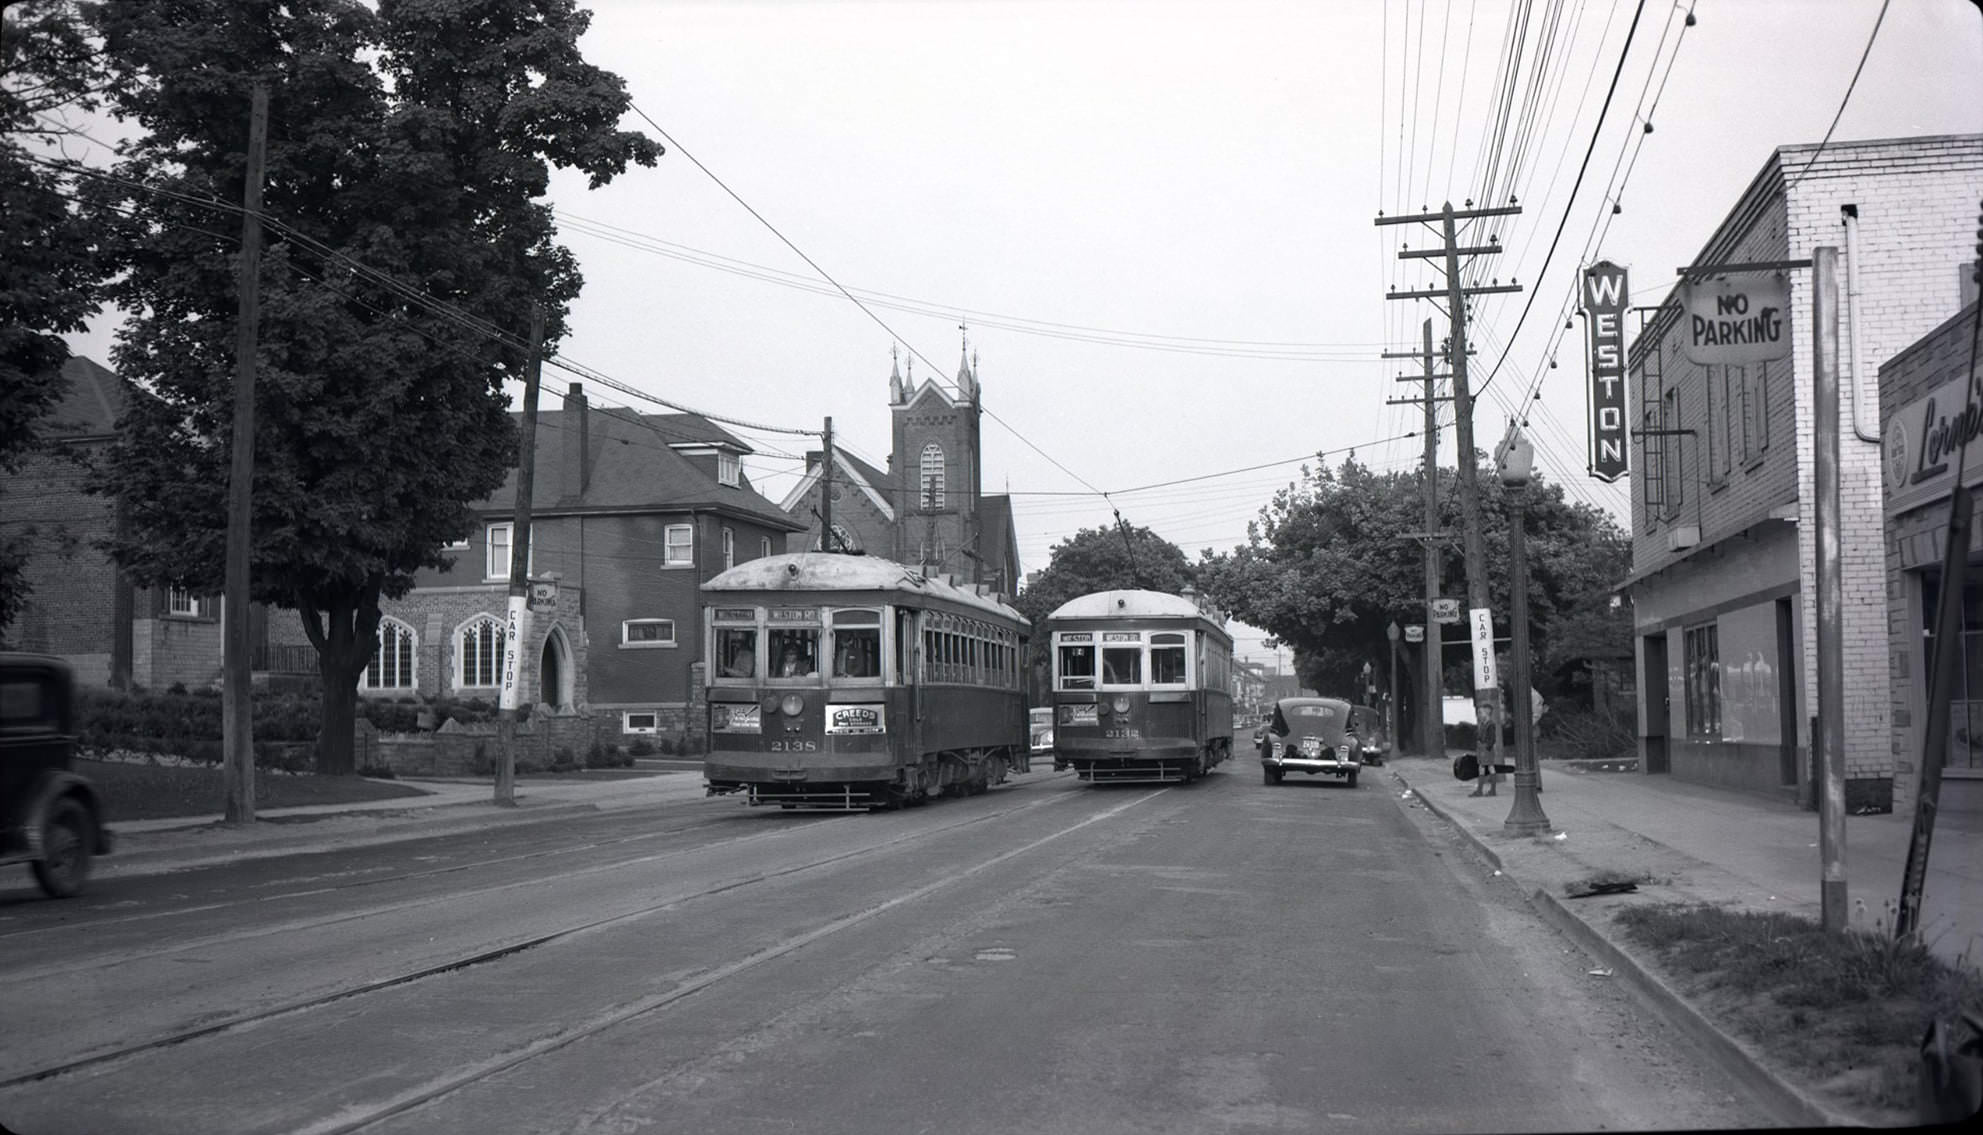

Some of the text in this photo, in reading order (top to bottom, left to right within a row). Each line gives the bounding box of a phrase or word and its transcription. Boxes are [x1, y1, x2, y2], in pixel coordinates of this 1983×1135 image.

[1717, 293, 1749, 316] NO
[1693, 307, 1782, 347] PARKING
[1588, 274, 1623, 463] WESTON
[538, 590, 547, 598] NO
[1433, 607, 1457, 618] PARKING
[505, 610, 517, 690] CAR STOP
[1479, 614, 1490, 683] CAR STOP
[771, 741, 816, 752] 2138
